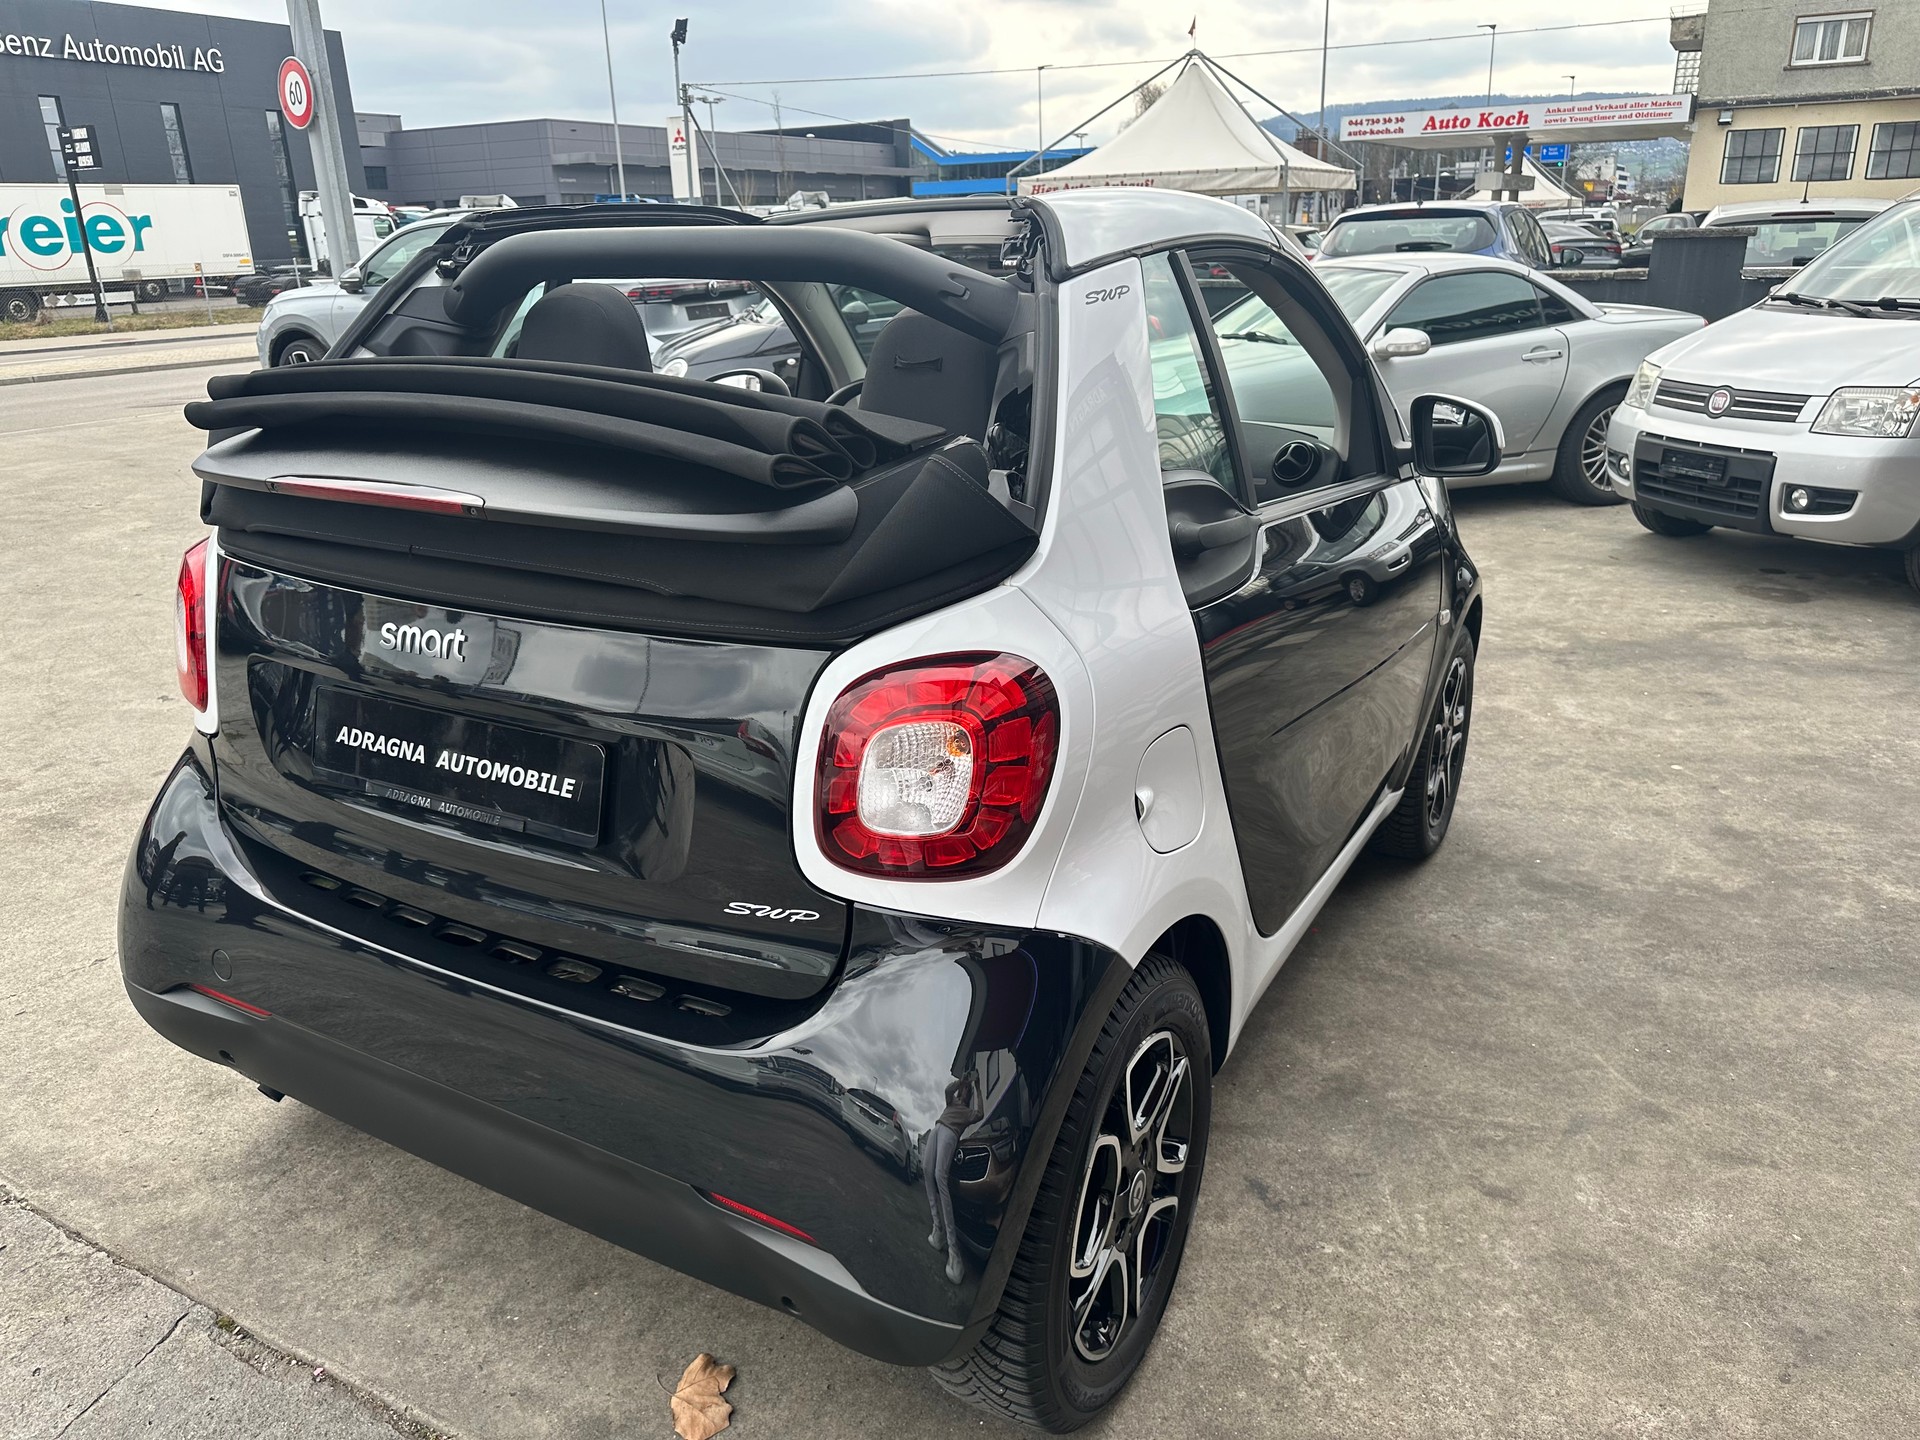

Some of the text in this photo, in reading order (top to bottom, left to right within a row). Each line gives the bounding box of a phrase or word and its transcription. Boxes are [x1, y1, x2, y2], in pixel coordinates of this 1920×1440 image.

[0, 33, 225, 73] enz Automobil AG
[289, 80, 303, 106] 60
[1544, 116, 1567, 124] sowie
[1568, 114, 1616, 123] Youngtimer
[1634, 110, 1673, 119] Oldtimer
[1545, 106, 1576, 114] Ankauf
[1594, 103, 1628, 111] Verkauf
[1629, 101, 1650, 109] aller
[1650, 100, 1682, 108] Marken
[1348, 116, 1405, 127] 044 730 36 36
[1422, 110, 1529, 131] Auto Koch
[1347, 126, 1404, 137] auto-koch.ch
[1085, 284, 1130, 305] SWP
[1713, 396, 1727, 408] FIAT
[379, 622, 468, 663] smart
[336, 726, 576, 798] ADRAGNA AUTOMOBILE
[385, 788, 500, 826] ADRAGNA AUTOMOBILE
[724, 902, 821, 923] SWP
